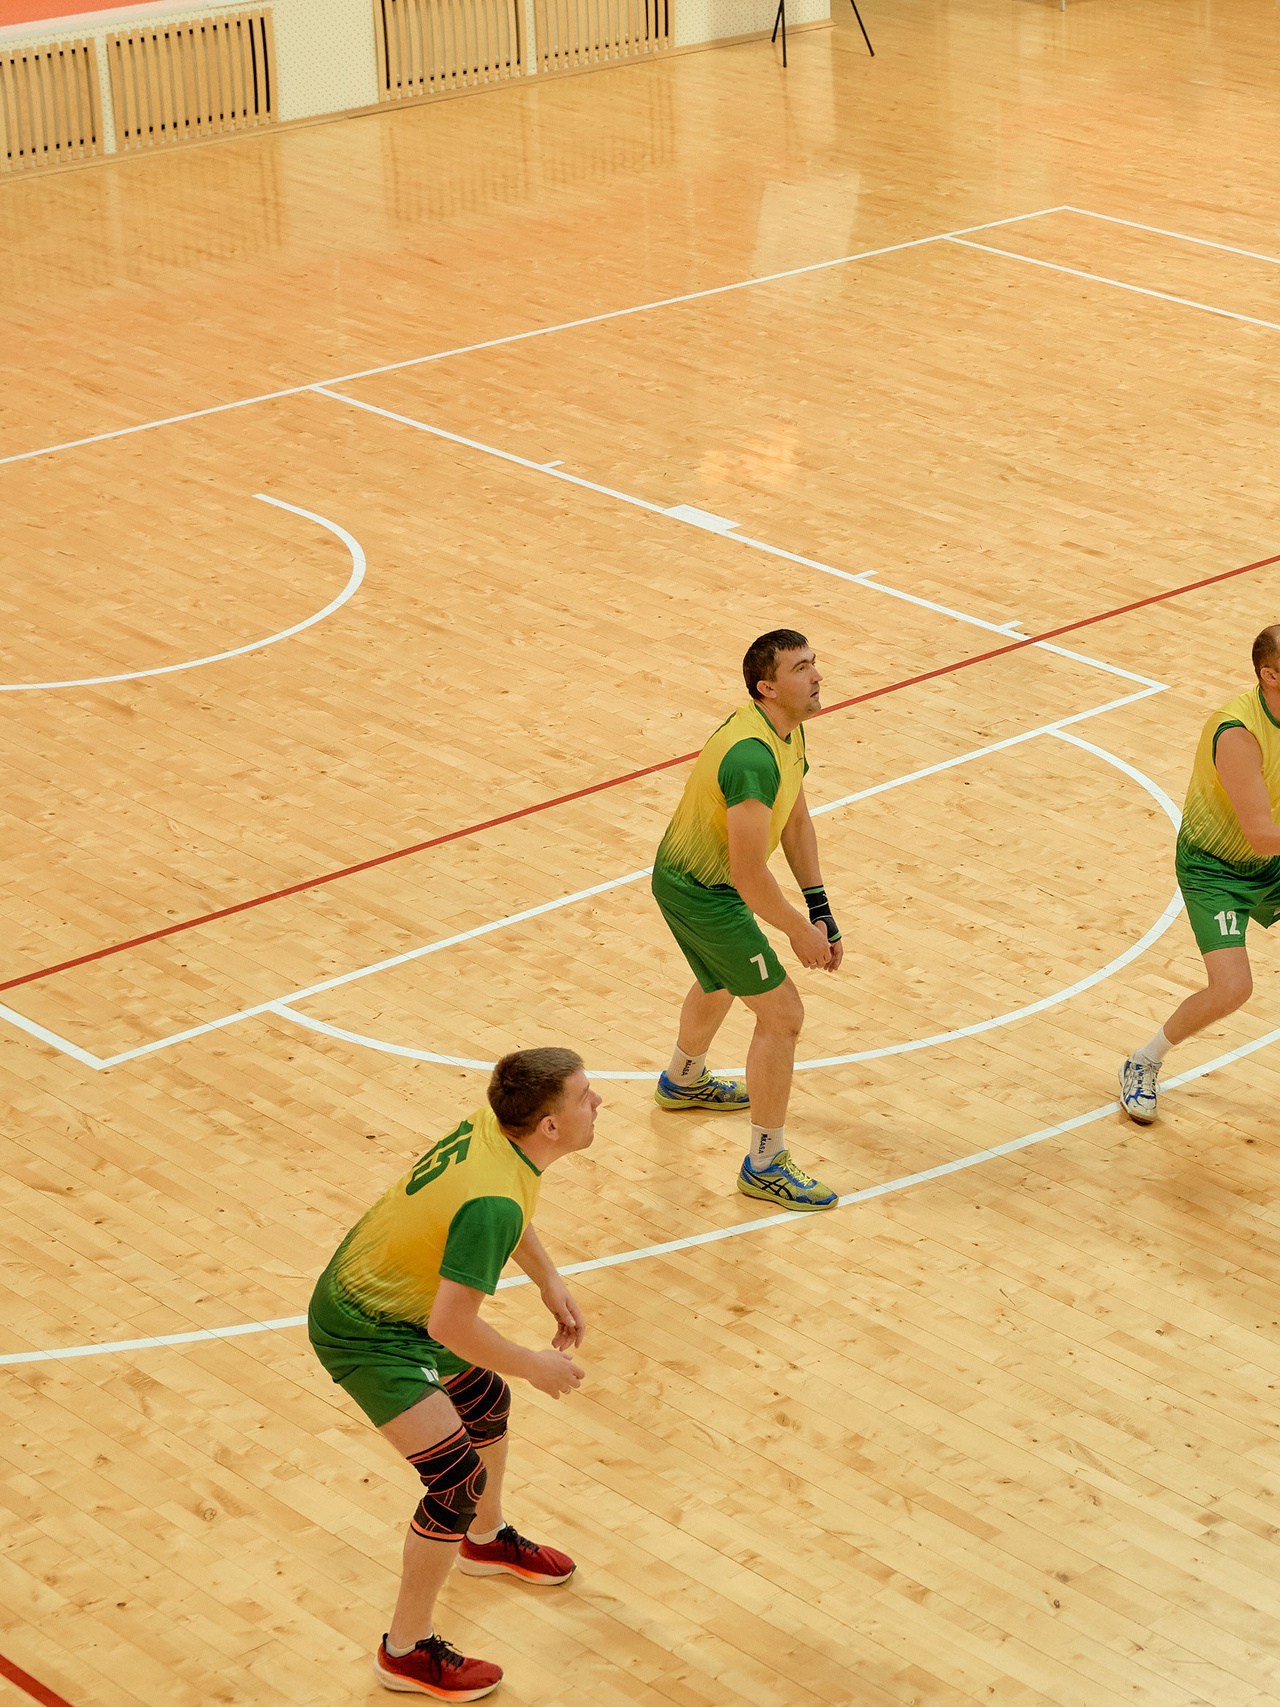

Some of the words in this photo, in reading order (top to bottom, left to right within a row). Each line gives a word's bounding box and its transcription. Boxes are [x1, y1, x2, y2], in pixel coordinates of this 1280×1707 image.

[1213, 910, 1241, 936] 12
[749, 952, 769, 981] 7
[405, 1120, 474, 1196] 15
